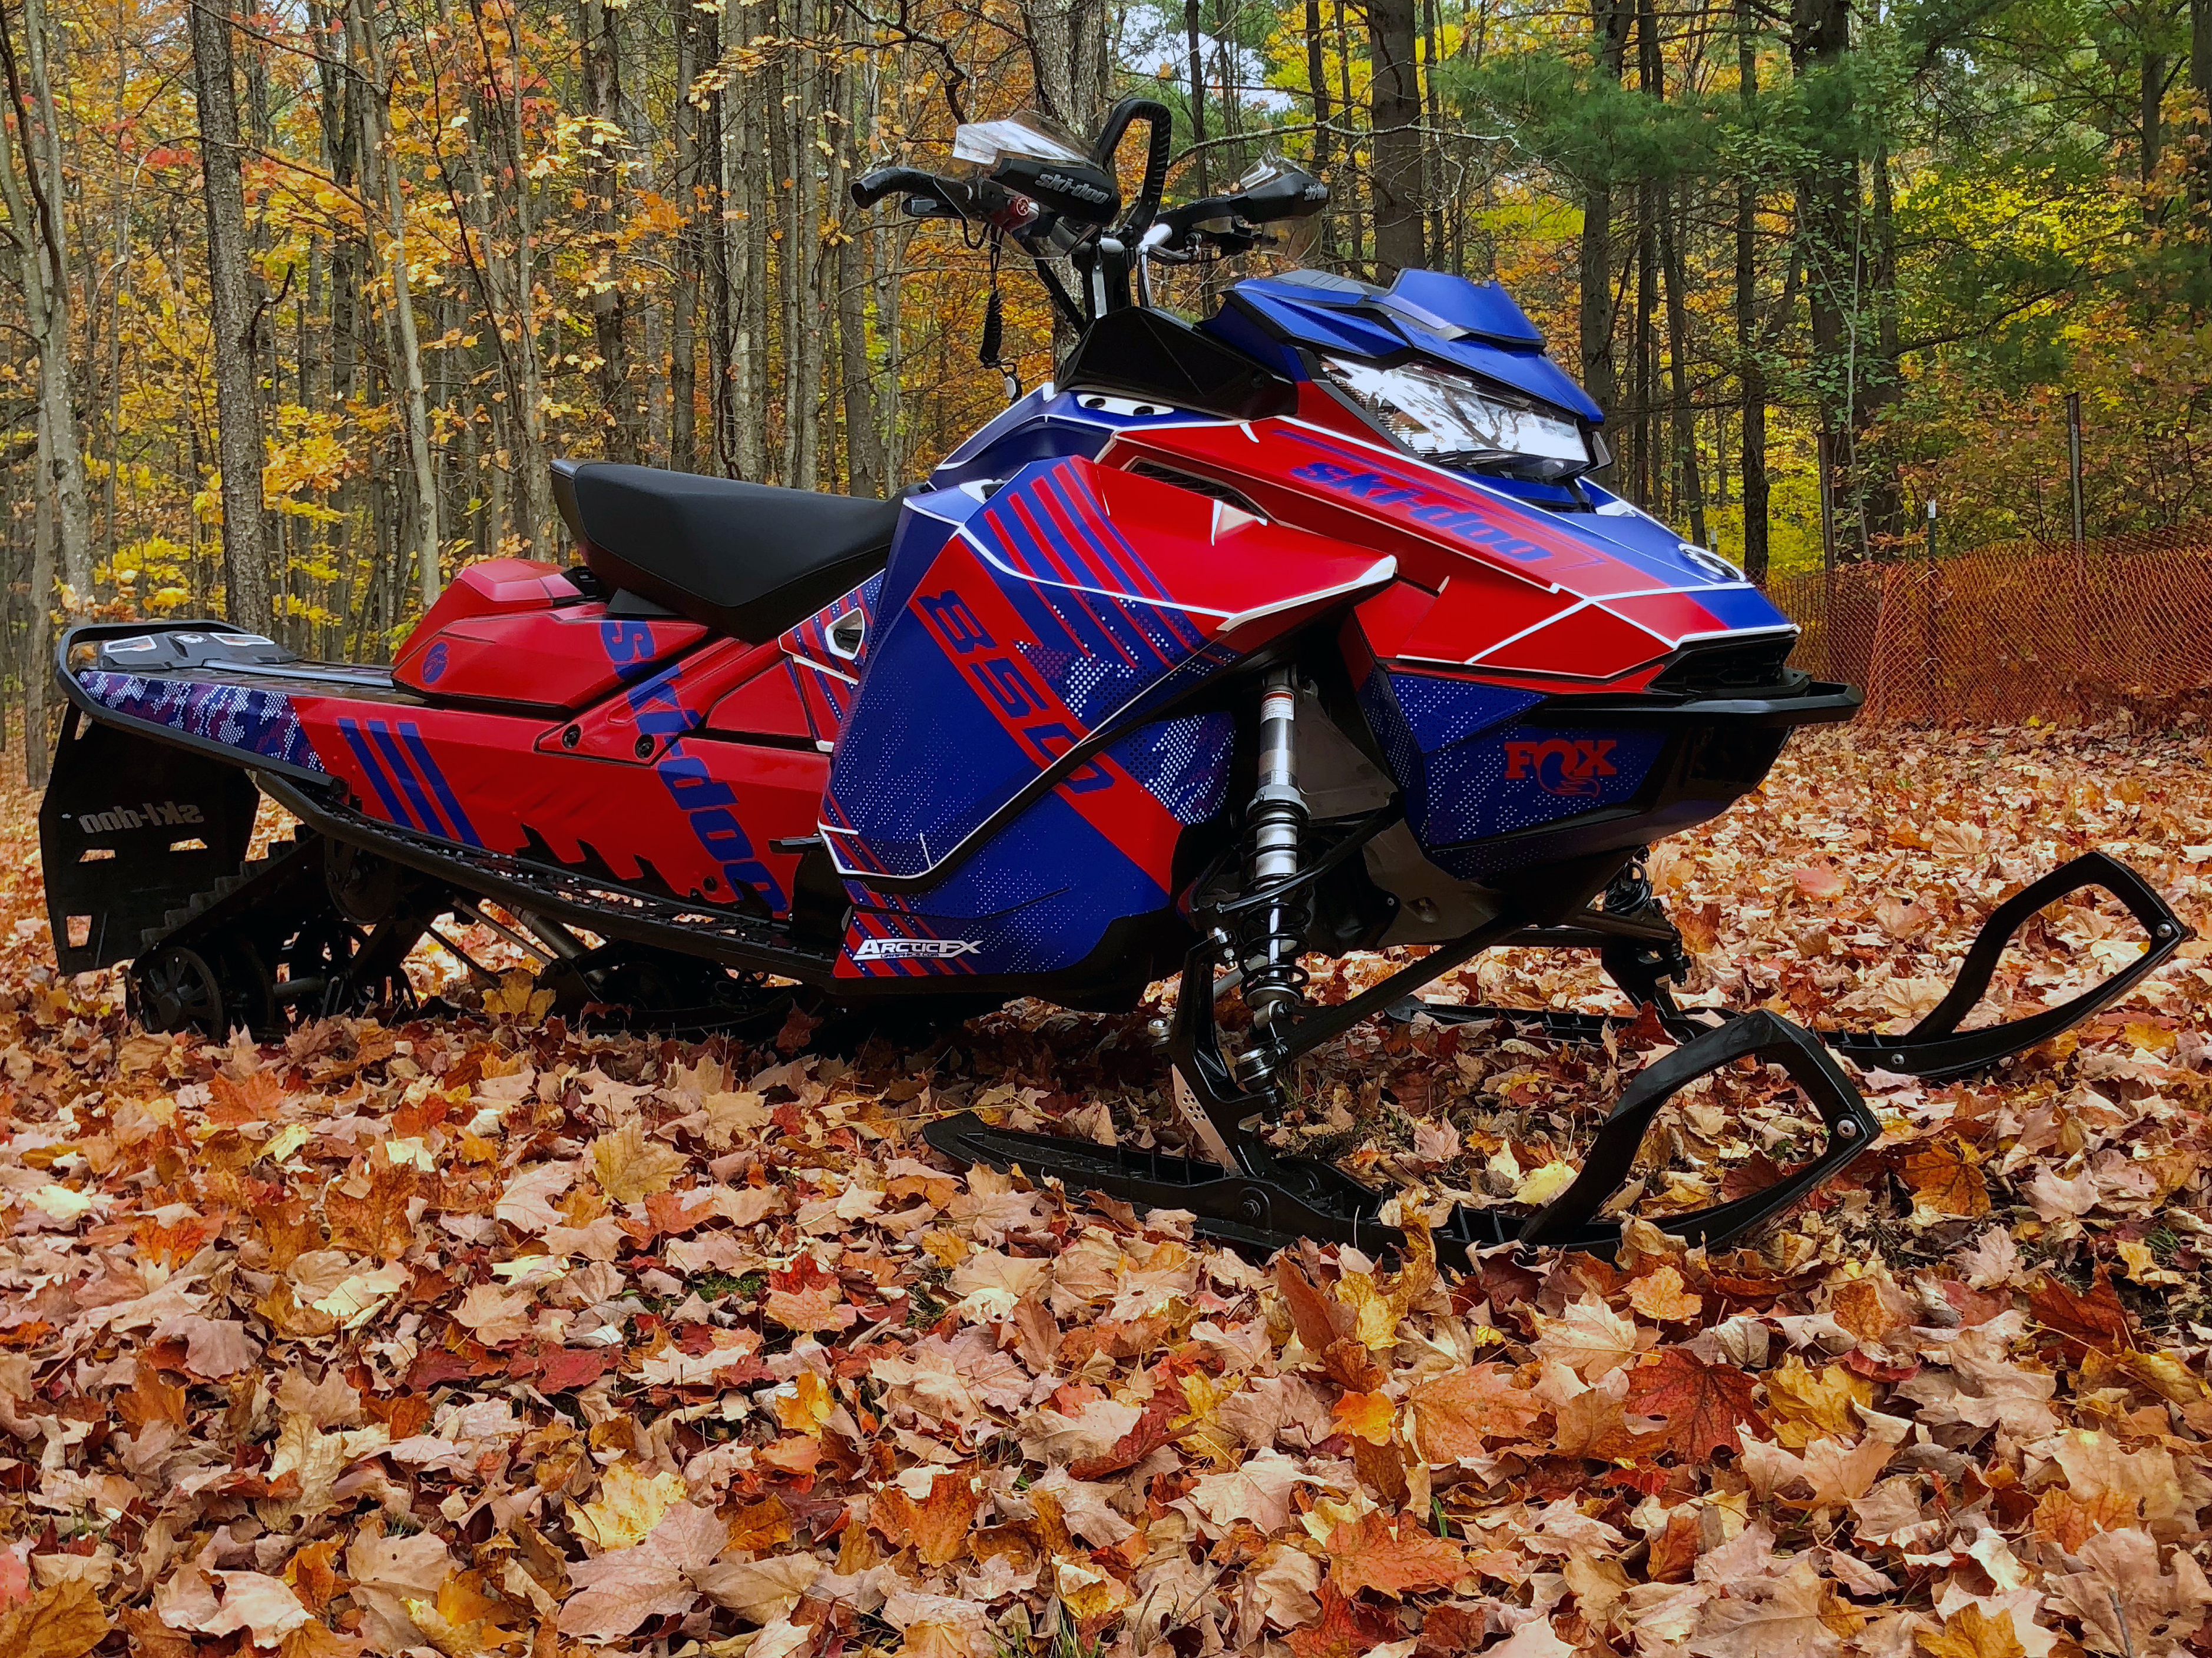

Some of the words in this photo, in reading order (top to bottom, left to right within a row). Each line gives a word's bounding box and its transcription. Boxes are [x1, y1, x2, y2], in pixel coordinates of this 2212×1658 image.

[1035, 174, 1109, 204] ski-doo
[916, 590, 1114, 794] 850
[1504, 738, 1617, 784] FOX
